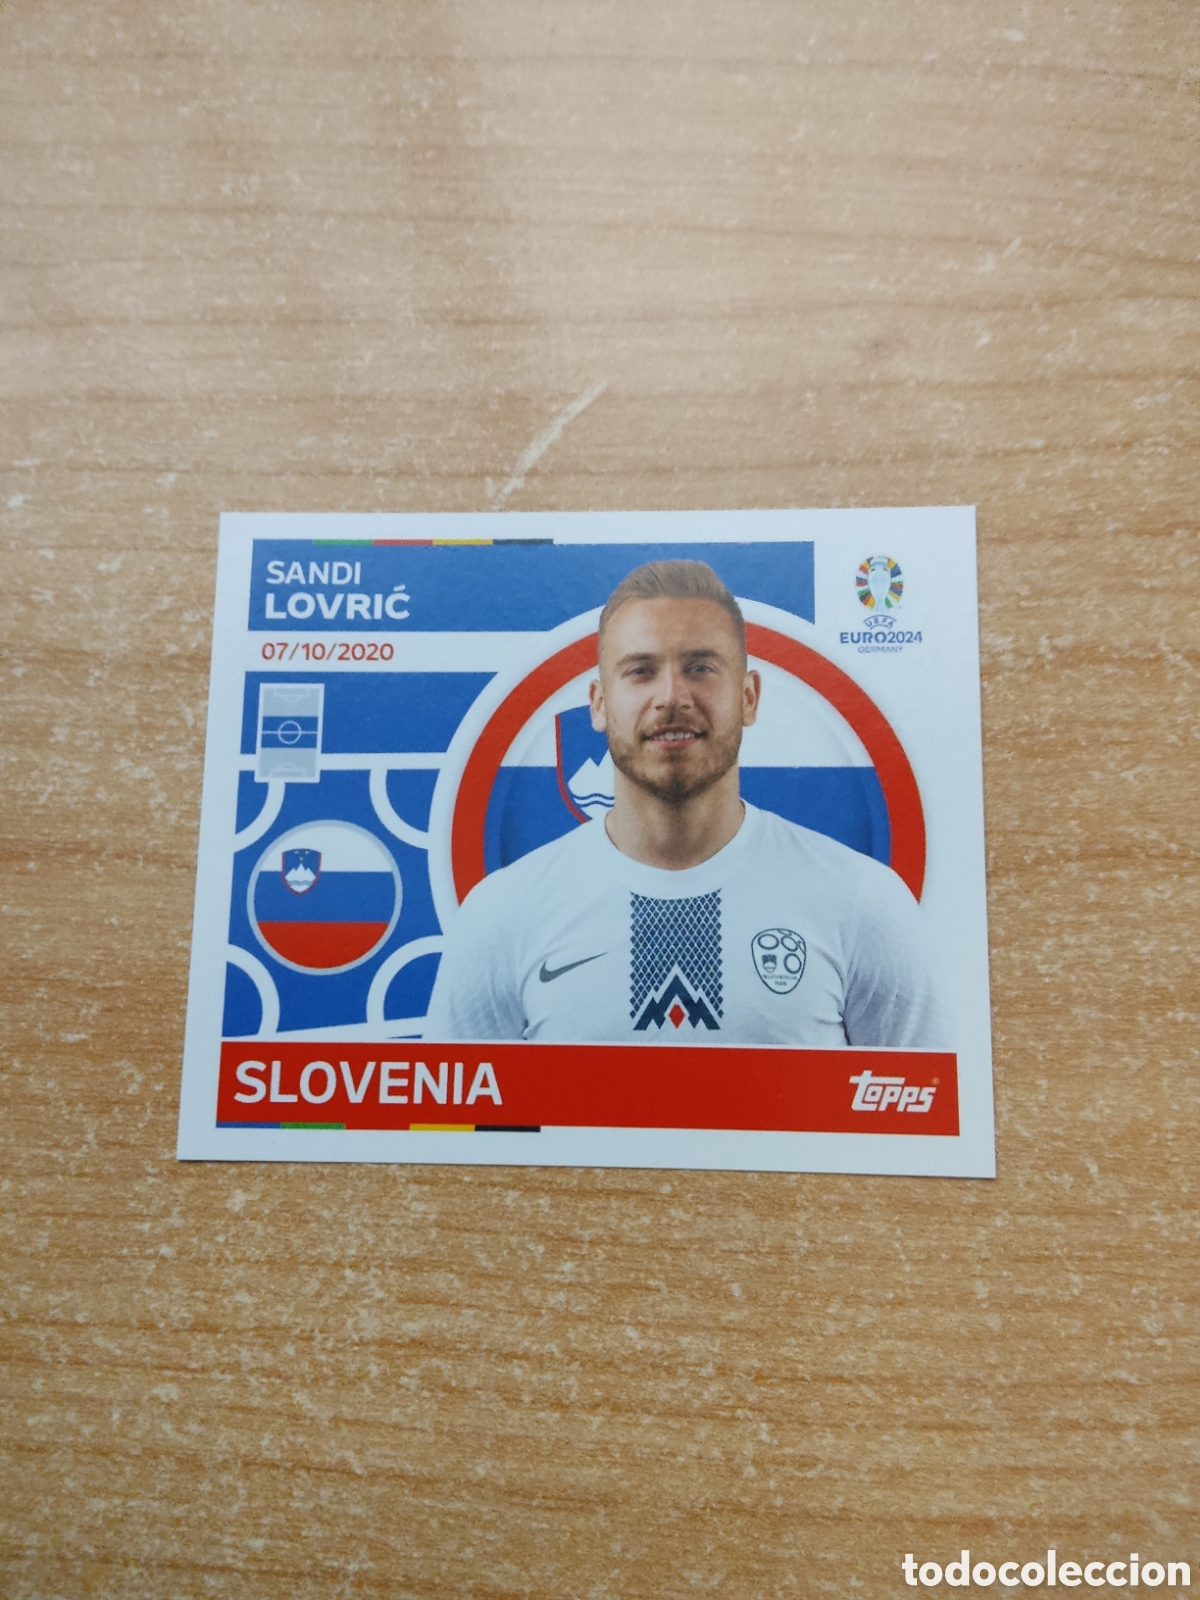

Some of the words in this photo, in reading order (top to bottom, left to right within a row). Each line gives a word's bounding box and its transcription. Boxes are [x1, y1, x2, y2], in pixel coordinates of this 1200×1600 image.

[266, 560, 361, 585] SANDI
[265, 584, 411, 619] LOVRIĆ
[865, 616, 894, 628] UEFA
[840, 631, 923, 644] EURO2024
[261, 642, 394, 661] 07/10/2020
[234, 1060, 503, 1105] SLOVENIA
